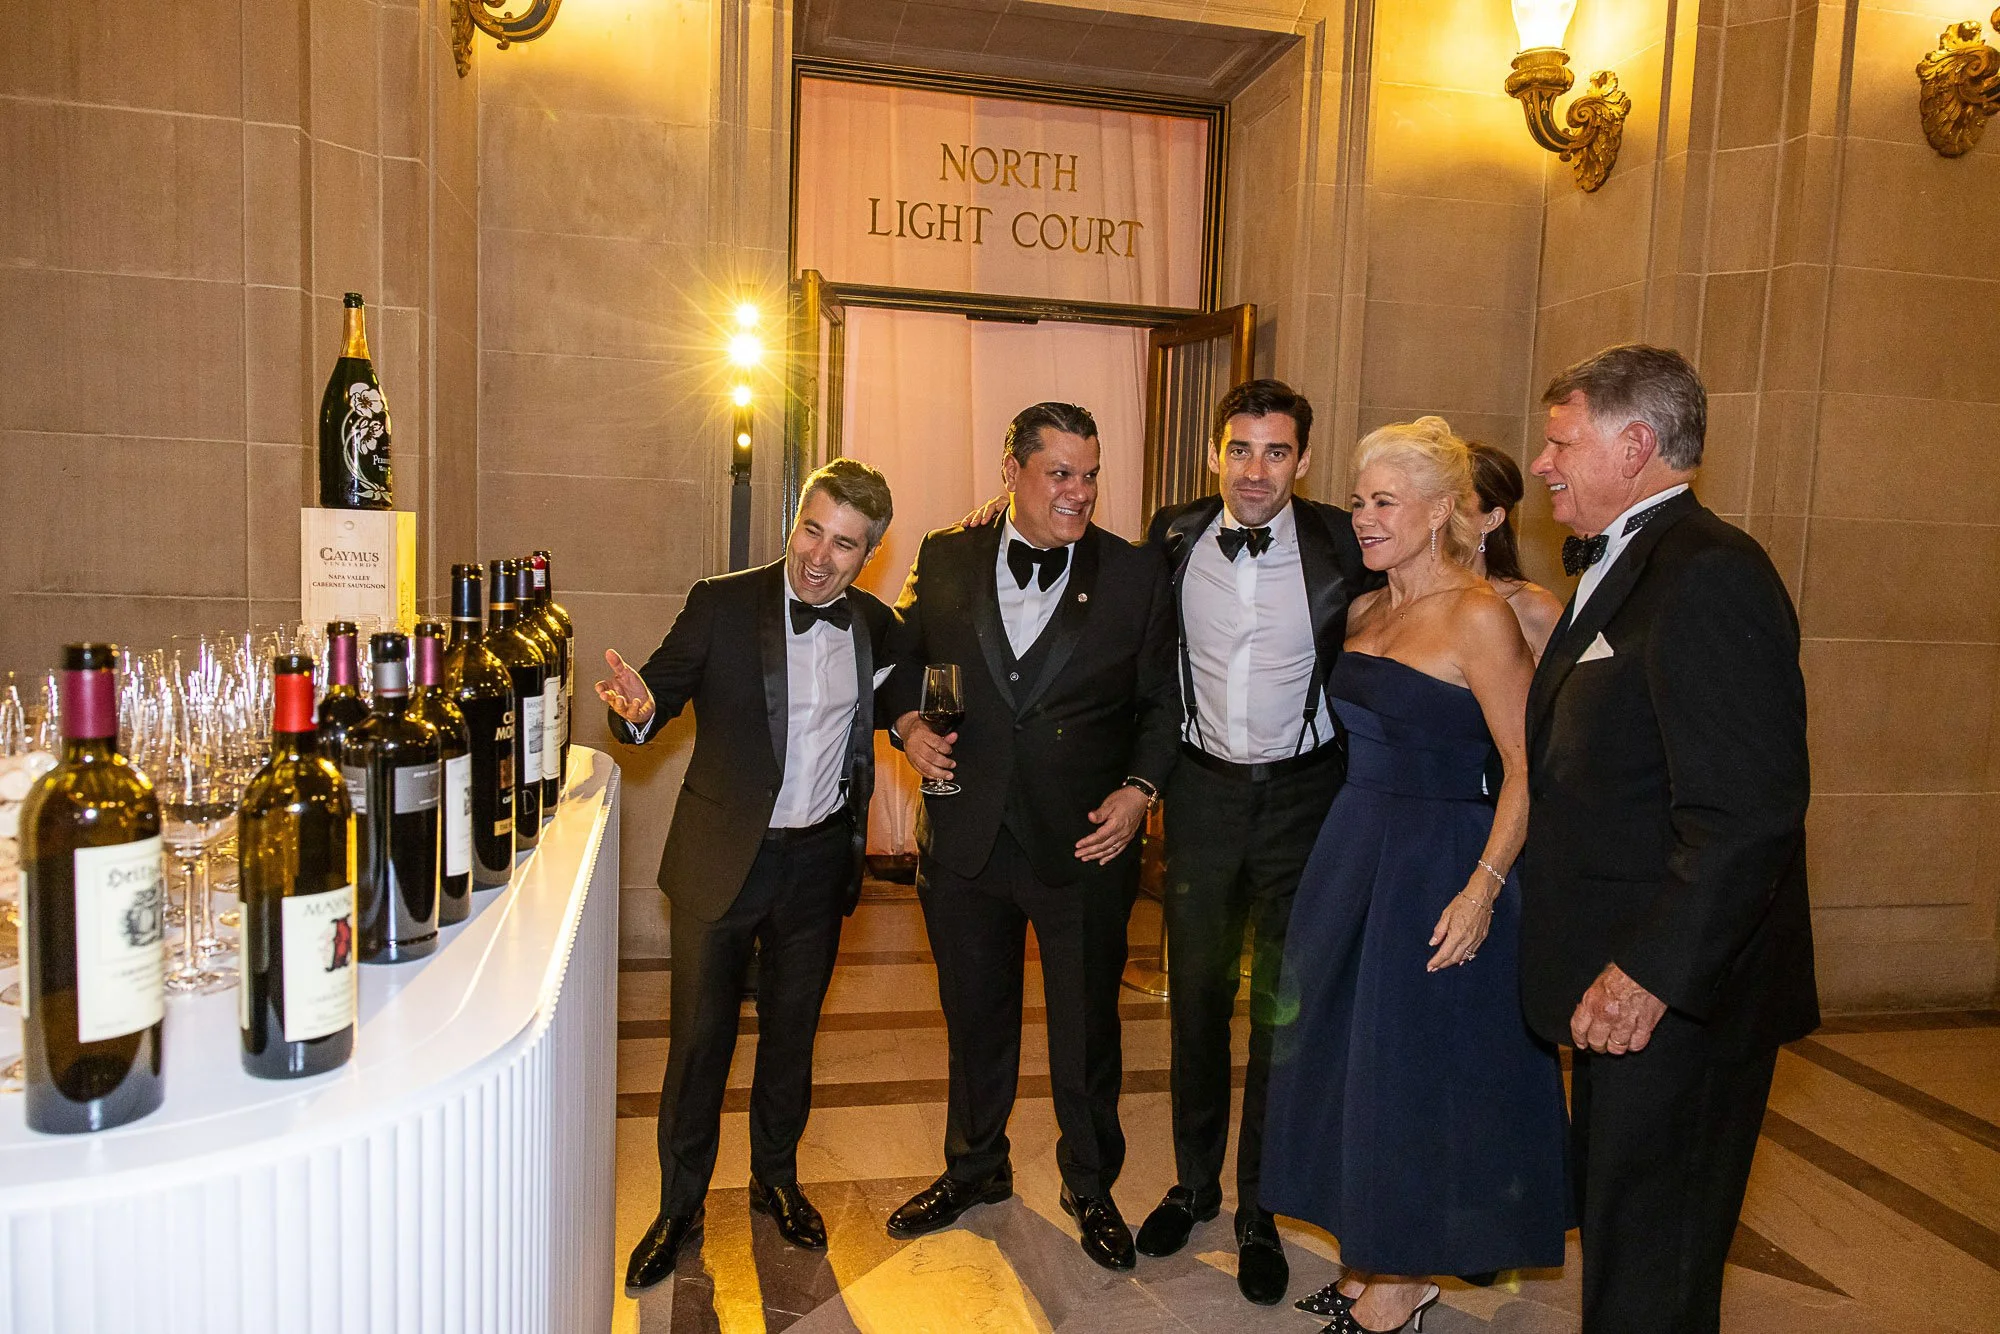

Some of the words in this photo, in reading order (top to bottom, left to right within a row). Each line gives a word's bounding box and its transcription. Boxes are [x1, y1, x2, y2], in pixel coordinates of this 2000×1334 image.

[939, 142, 1078, 192] NORTH
[867, 197, 994, 245] LIGHT
[1011, 211, 1144, 258] COURT
[320, 547, 379, 561] CAYMUS
[347, 582, 386, 590] SAUVIGNON
